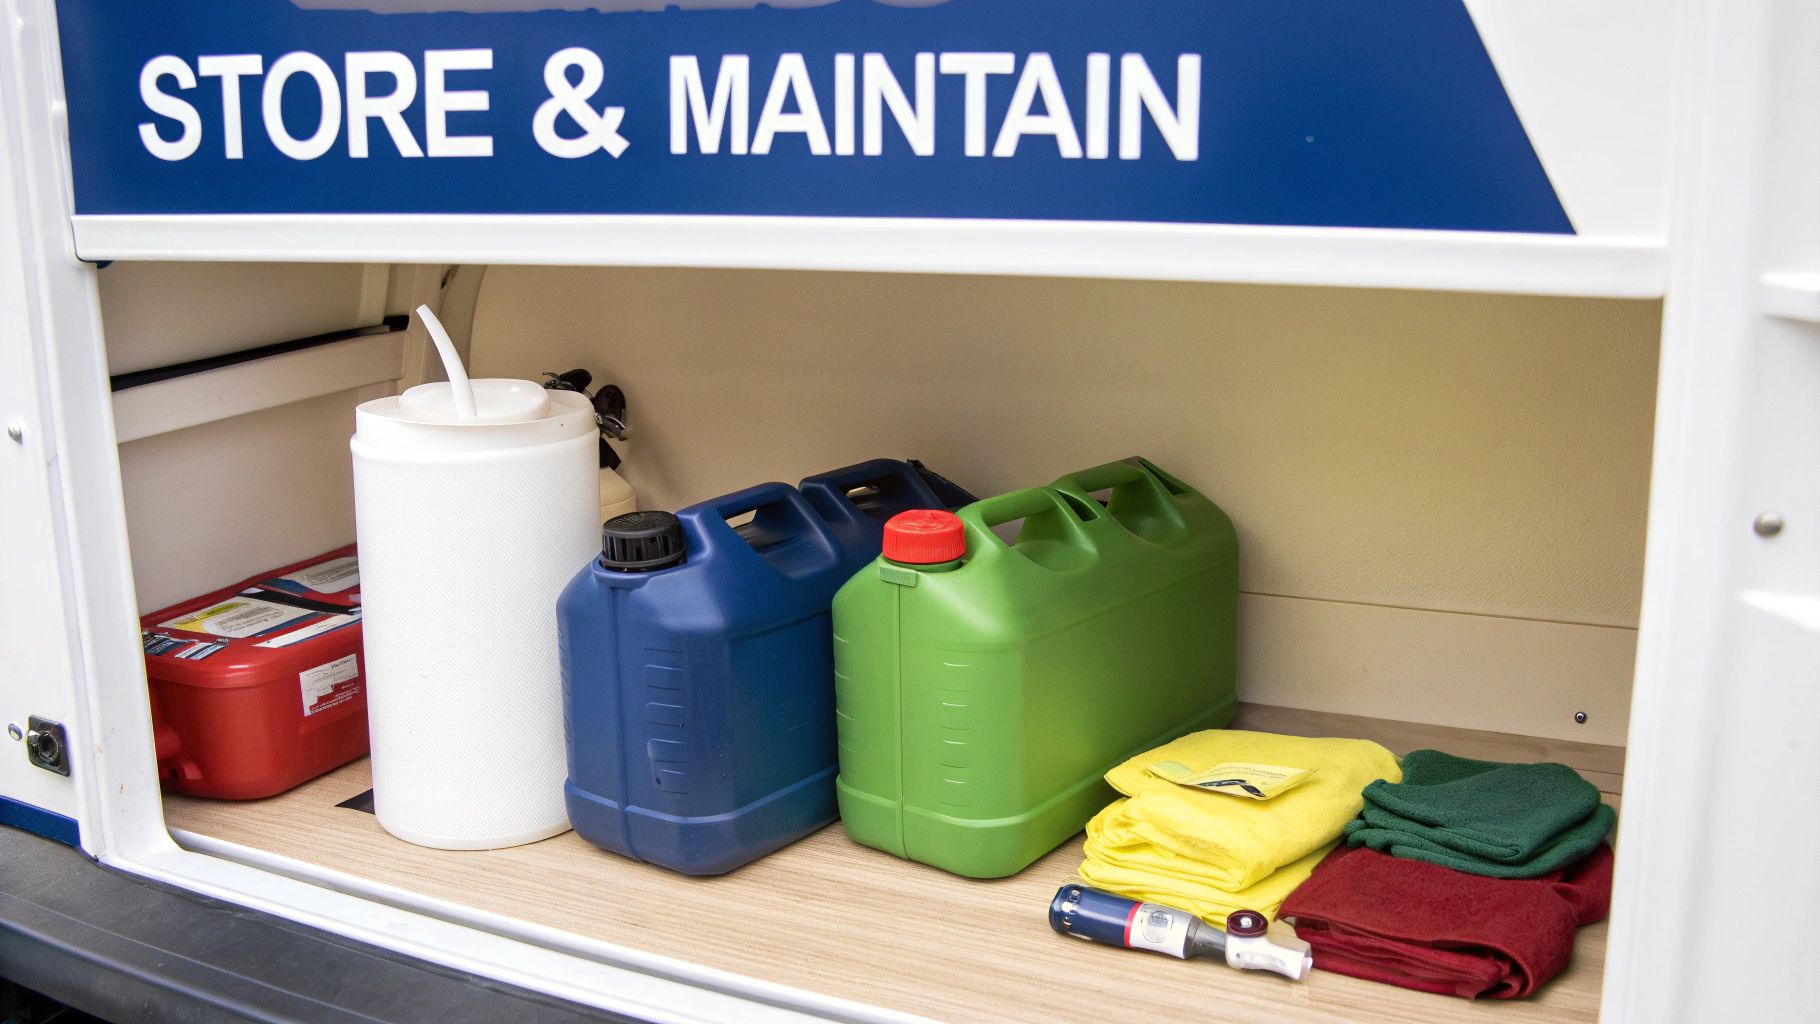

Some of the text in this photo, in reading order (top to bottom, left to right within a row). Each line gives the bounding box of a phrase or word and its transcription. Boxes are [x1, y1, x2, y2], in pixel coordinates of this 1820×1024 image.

[138, 46, 1202, 162] STORE & MAINTAIN
